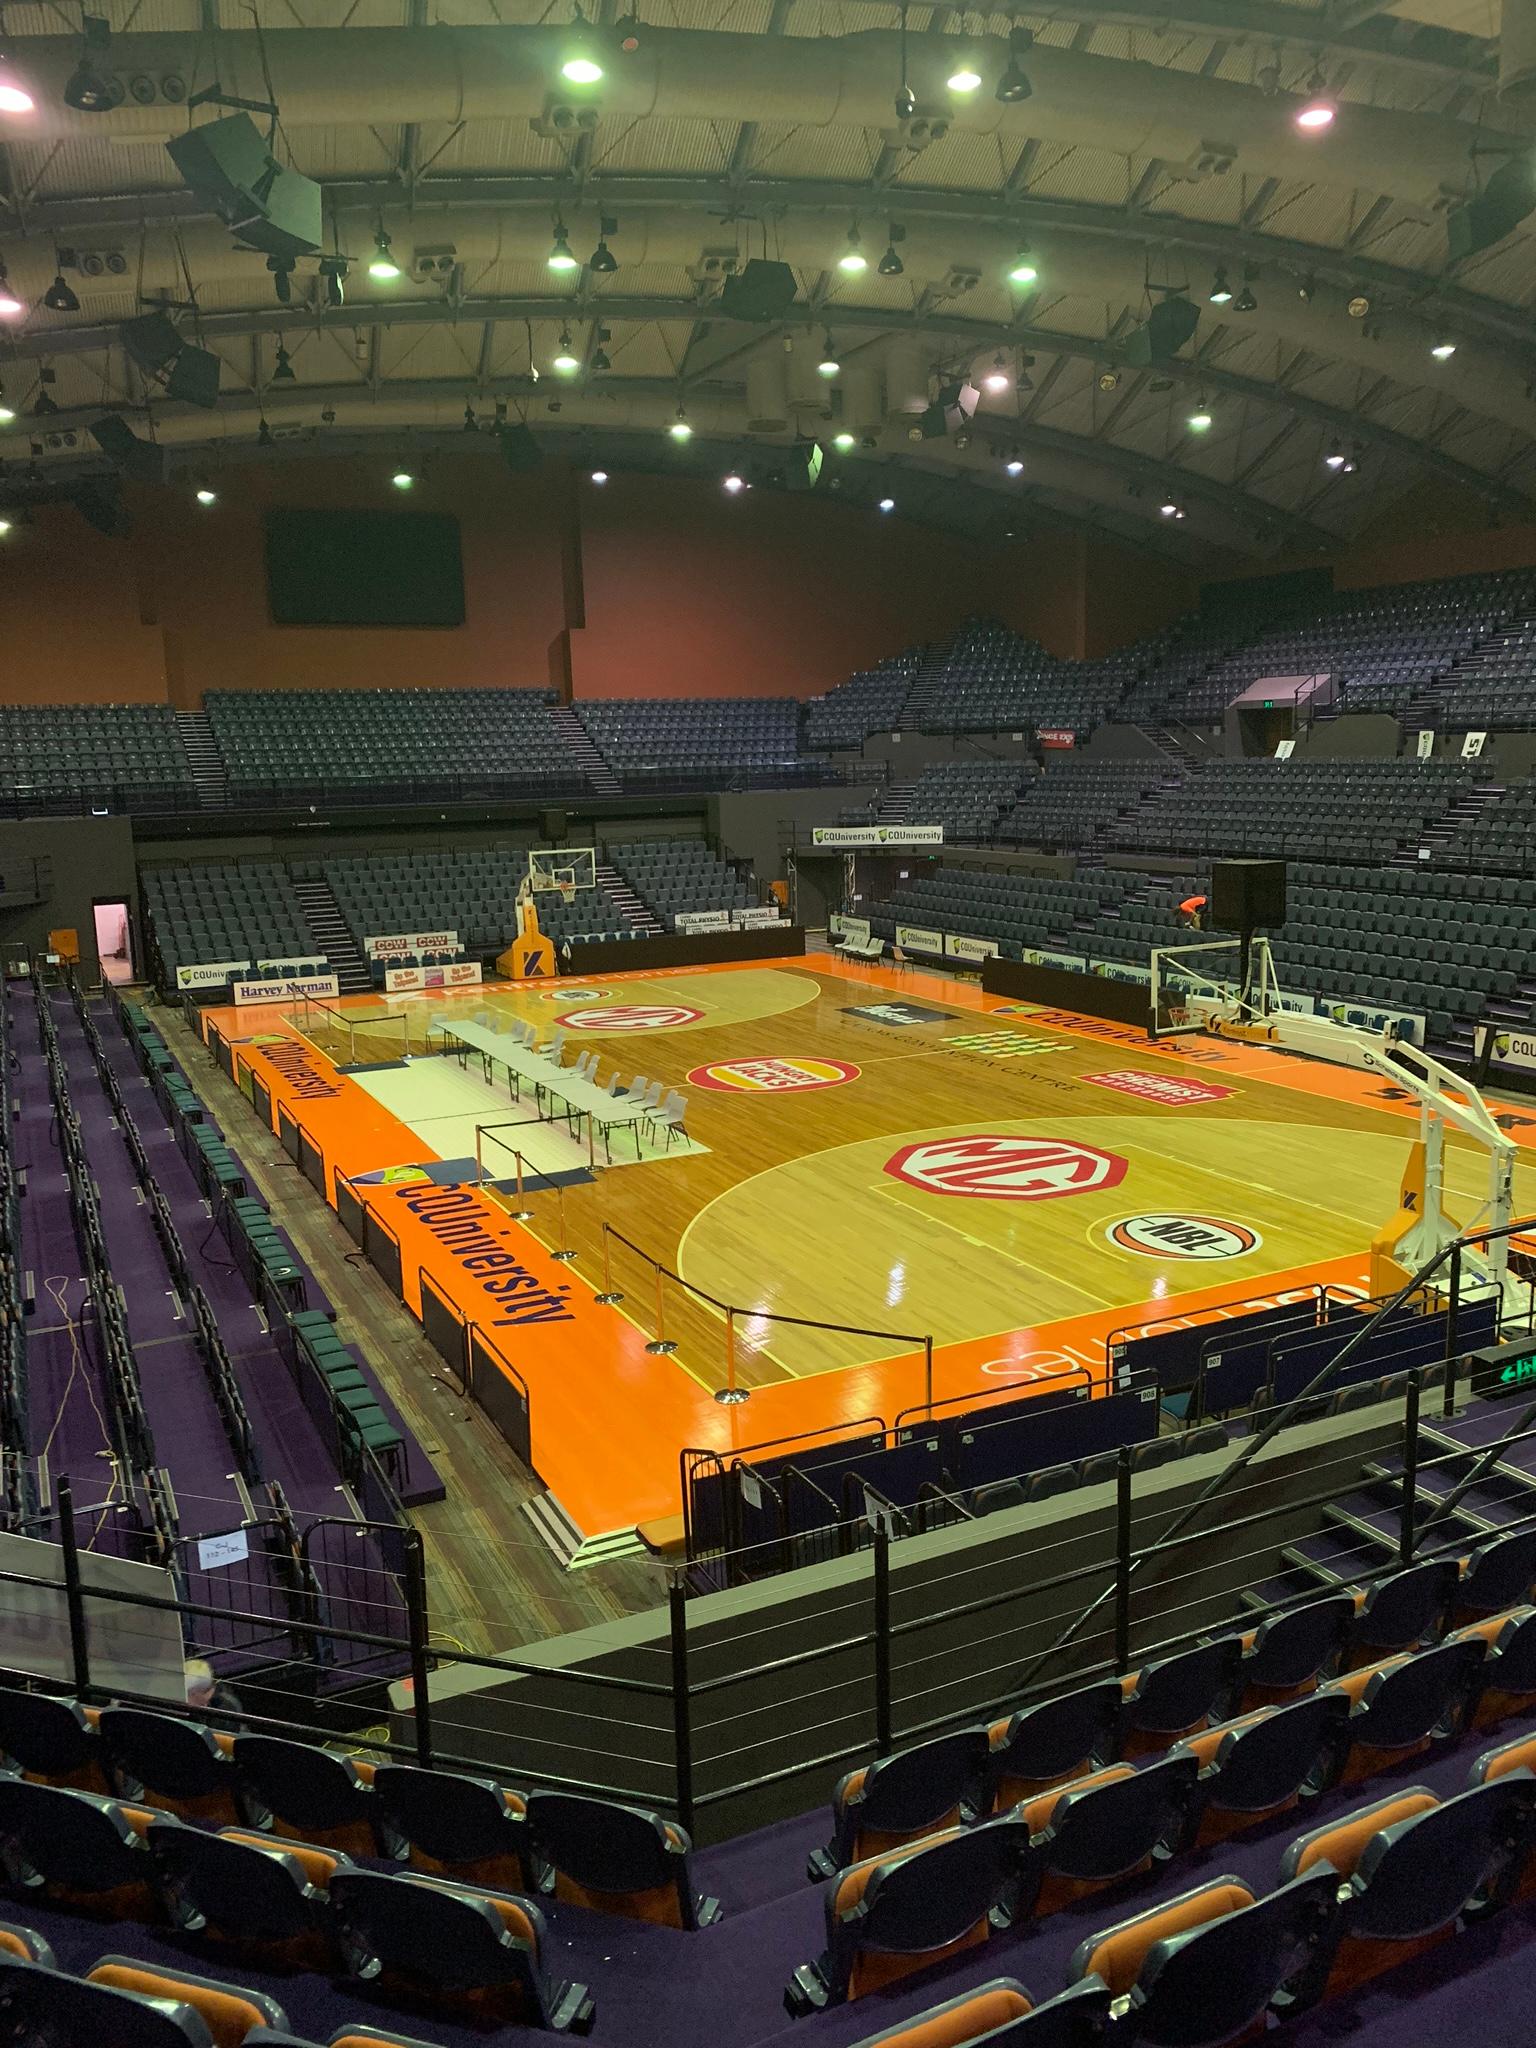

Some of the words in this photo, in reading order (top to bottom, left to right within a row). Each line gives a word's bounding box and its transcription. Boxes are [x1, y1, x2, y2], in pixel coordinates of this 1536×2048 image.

[824, 832, 876, 842] CQUniversity
[888, 830, 942, 842] CQUniversity
[842, 921, 868, 936] CQUniversity
[376, 939, 406, 950] CCW
[418, 936, 447, 947] CCW
[907, 932, 938, 948] CQUniversity
[240, 986, 284, 997] Harvey
[256, 1042, 345, 1100] CQUniversity
[1106, 1071, 1218, 1100] CHEMIST
[1141, 1220, 1228, 1252] NBL
[396, 1182, 577, 1328] CQUniversity
[1208, 1357, 1221, 1366] 907
